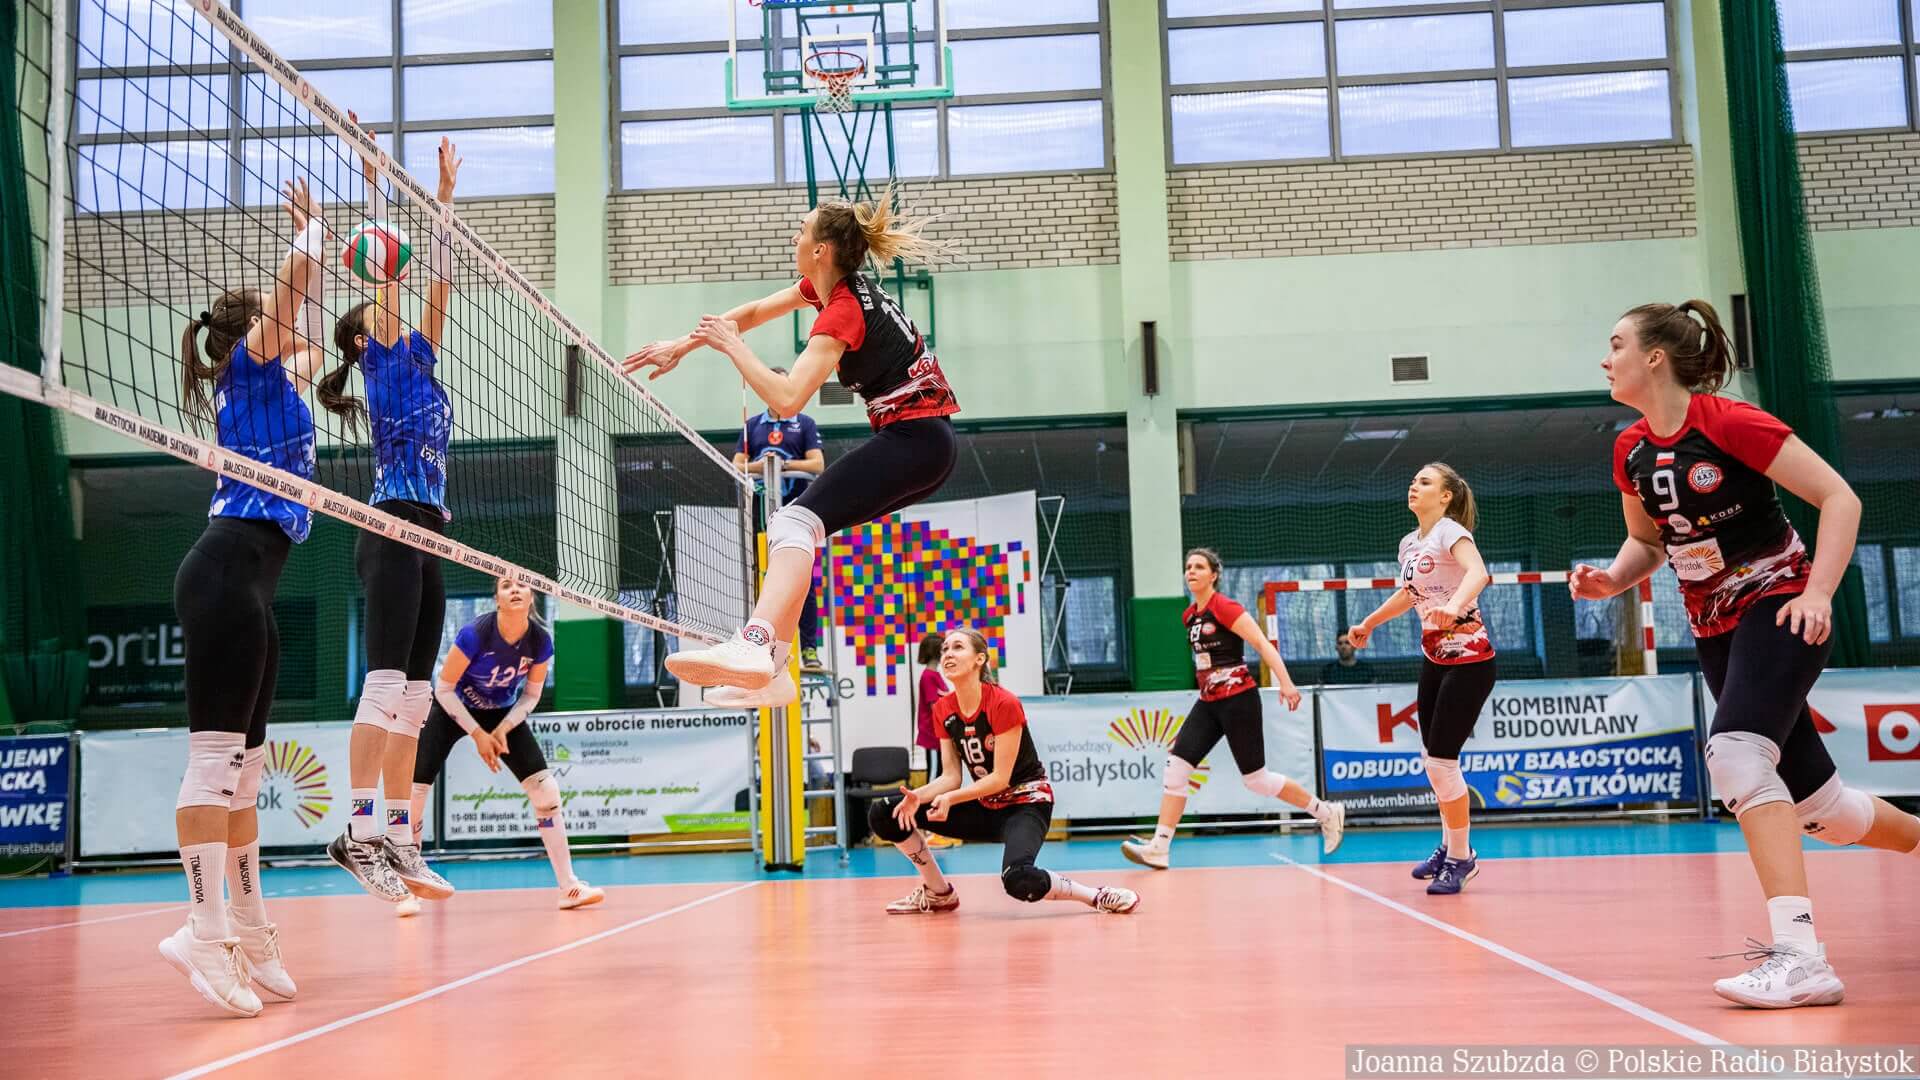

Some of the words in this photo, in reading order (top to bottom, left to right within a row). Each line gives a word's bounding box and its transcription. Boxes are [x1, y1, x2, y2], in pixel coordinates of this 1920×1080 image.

[1652, 469, 1679, 511] 9
[486, 665, 516, 688] 12
[1492, 695, 1609, 717] KOMBINAT
[533, 719, 561, 734] two
[567, 721, 579, 732] w
[586, 716, 645, 732] obrocie
[651, 714, 747, 729] nieruchomo
[1493, 715, 1639, 739] BUDOWLANY
[0, 746, 64, 769] JEMY
[961, 738, 986, 764] 18
[1332, 753, 1520, 780] ODBUDOJEMY
[1524, 746, 1683, 771] BIAŁOSTOCKĄ
[0, 769, 47, 794] CKĄ
[1050, 755, 1156, 787] Białystok
[1526, 768, 1682, 800] SIATKÓWKĘ
[189, 854, 204, 904] TOMASOVIA
[238, 853, 253, 895] TOMASOVIA
